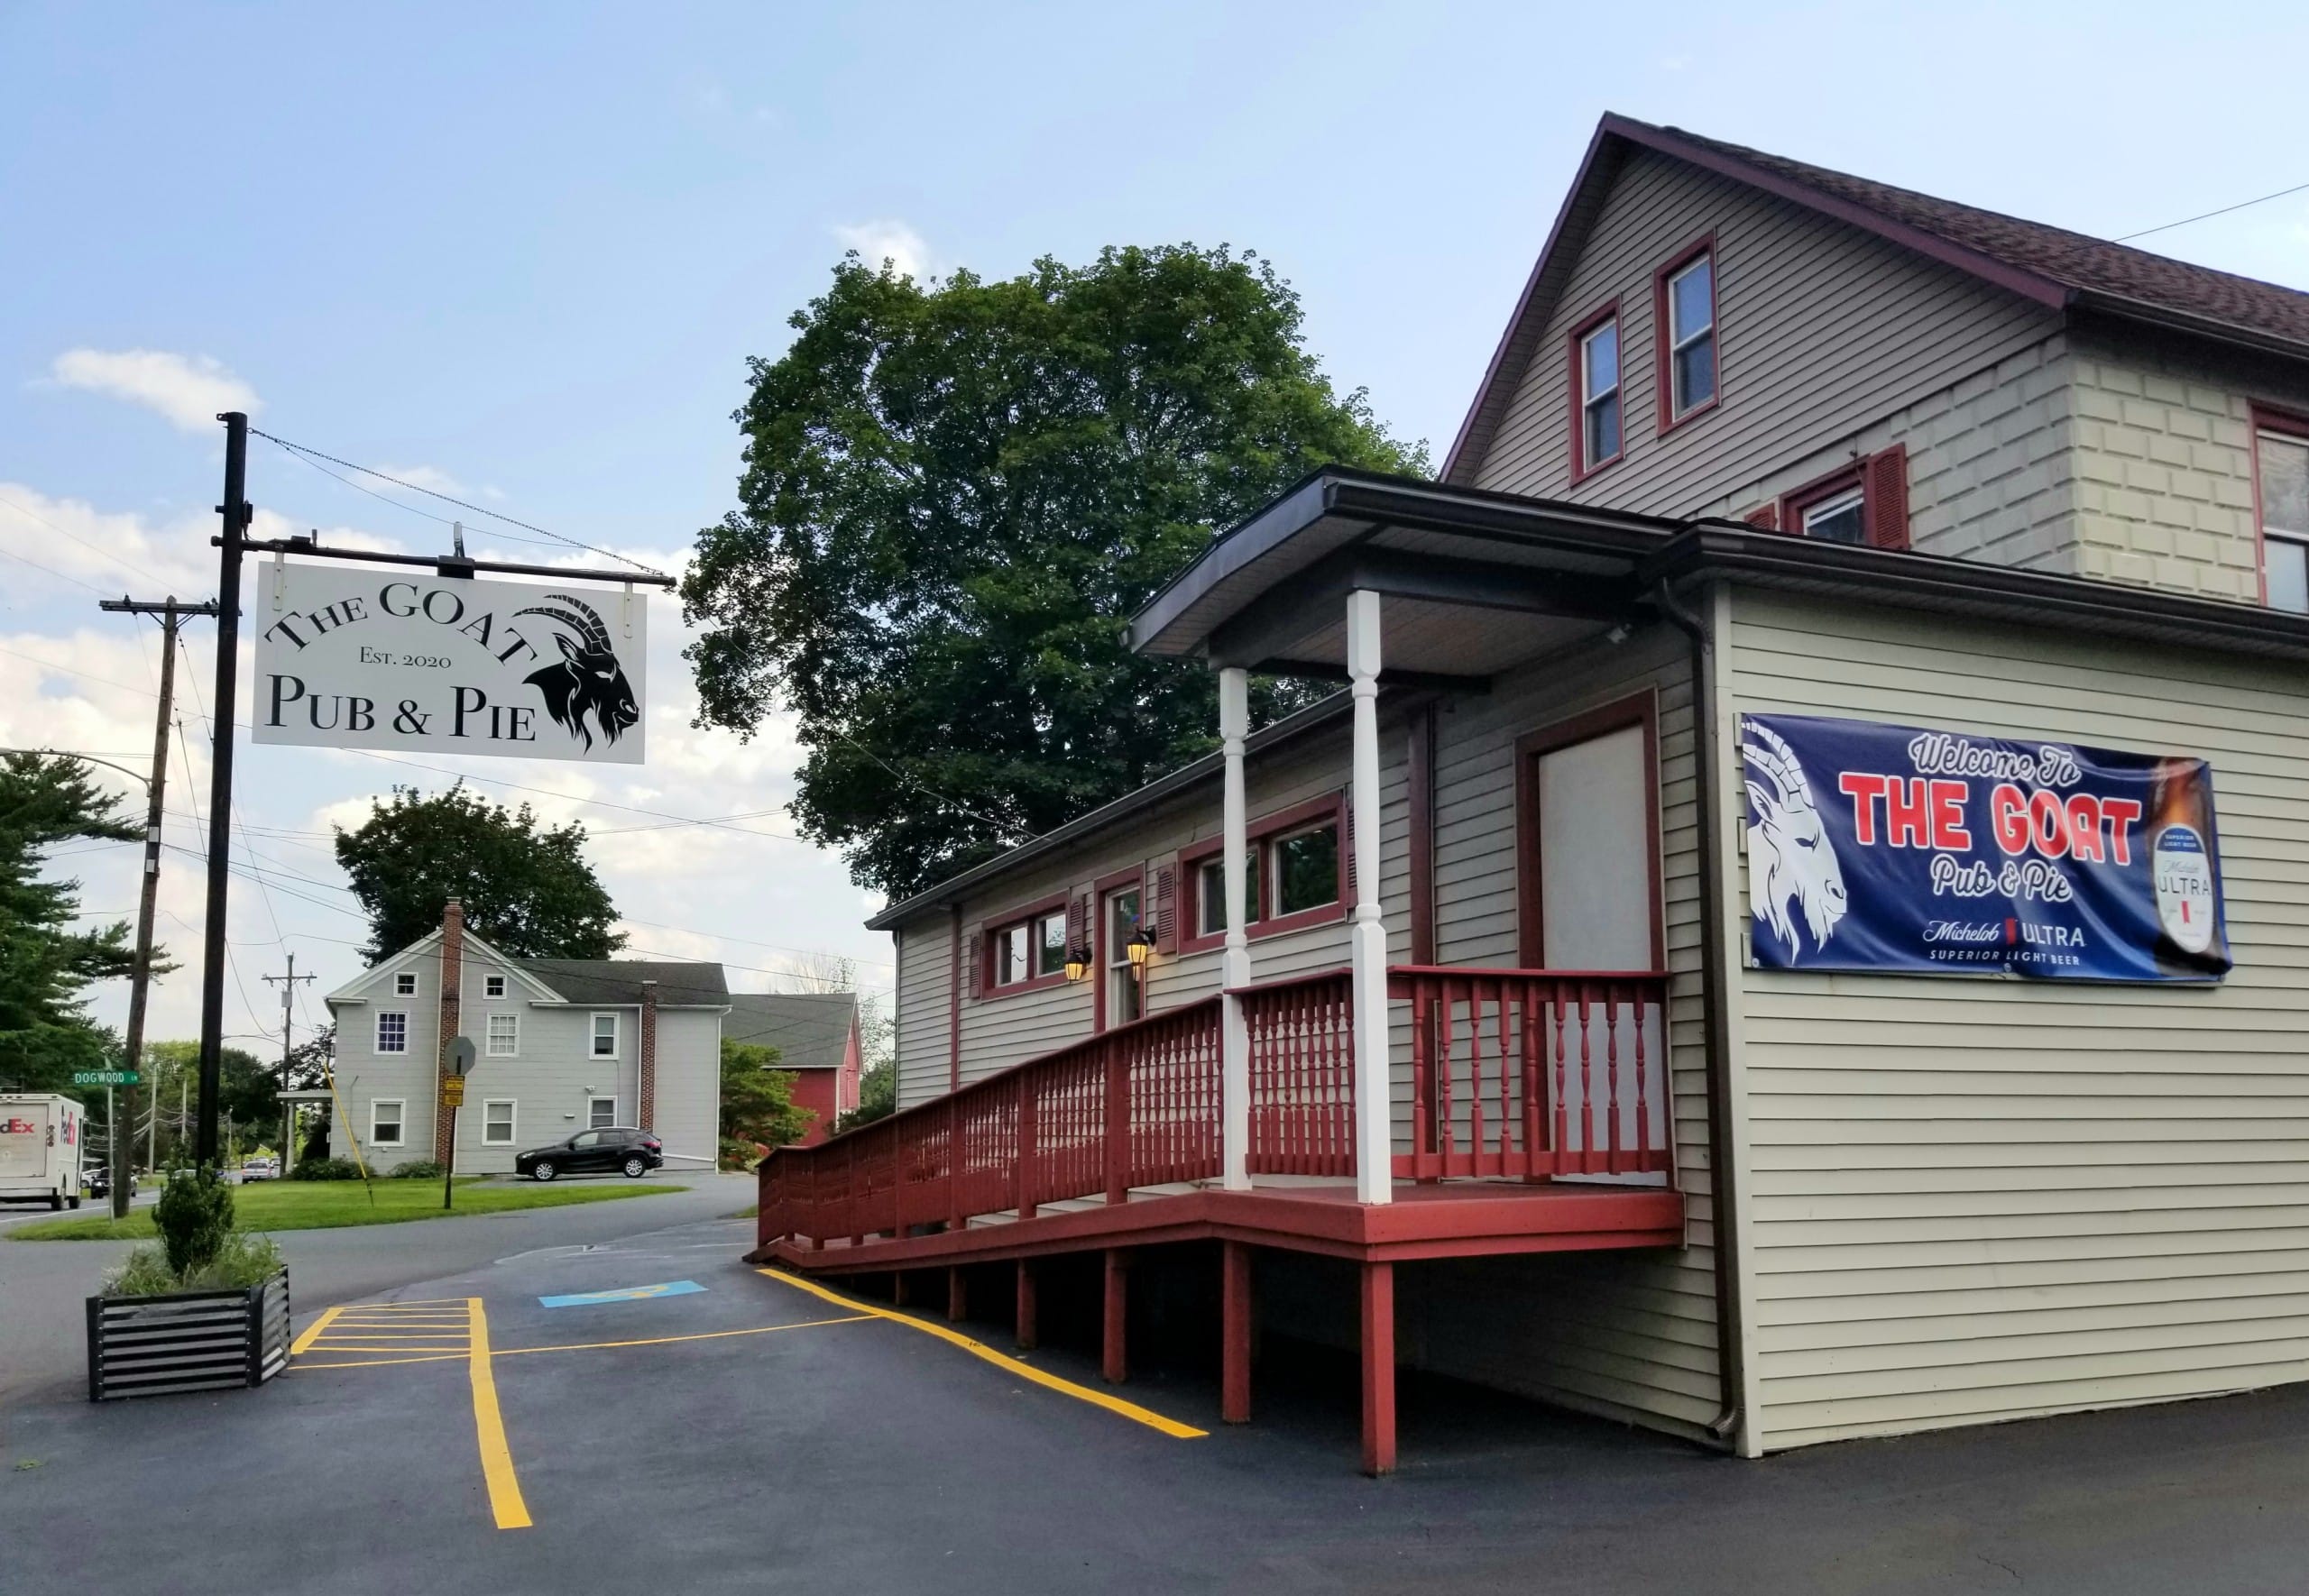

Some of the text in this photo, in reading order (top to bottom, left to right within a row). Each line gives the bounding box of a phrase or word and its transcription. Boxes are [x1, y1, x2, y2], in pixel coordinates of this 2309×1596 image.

[264, 582, 538, 666] THE GOAT
[402, 655, 452, 670] 2020
[264, 673, 536, 741] PUB & PIE
[1909, 732, 2083, 787] Welcome To
[1838, 771, 2143, 867] THE GOAT
[1930, 853, 2074, 903] Pub & Pie
[2157, 876, 2212, 896] ULTRA
[1922, 920, 2086, 948] Michelob ULTRA
[1928, 949, 2081, 967] SUPERIOR LIGHT BEER
[74, 1071, 124, 1084] DOGWOOD
